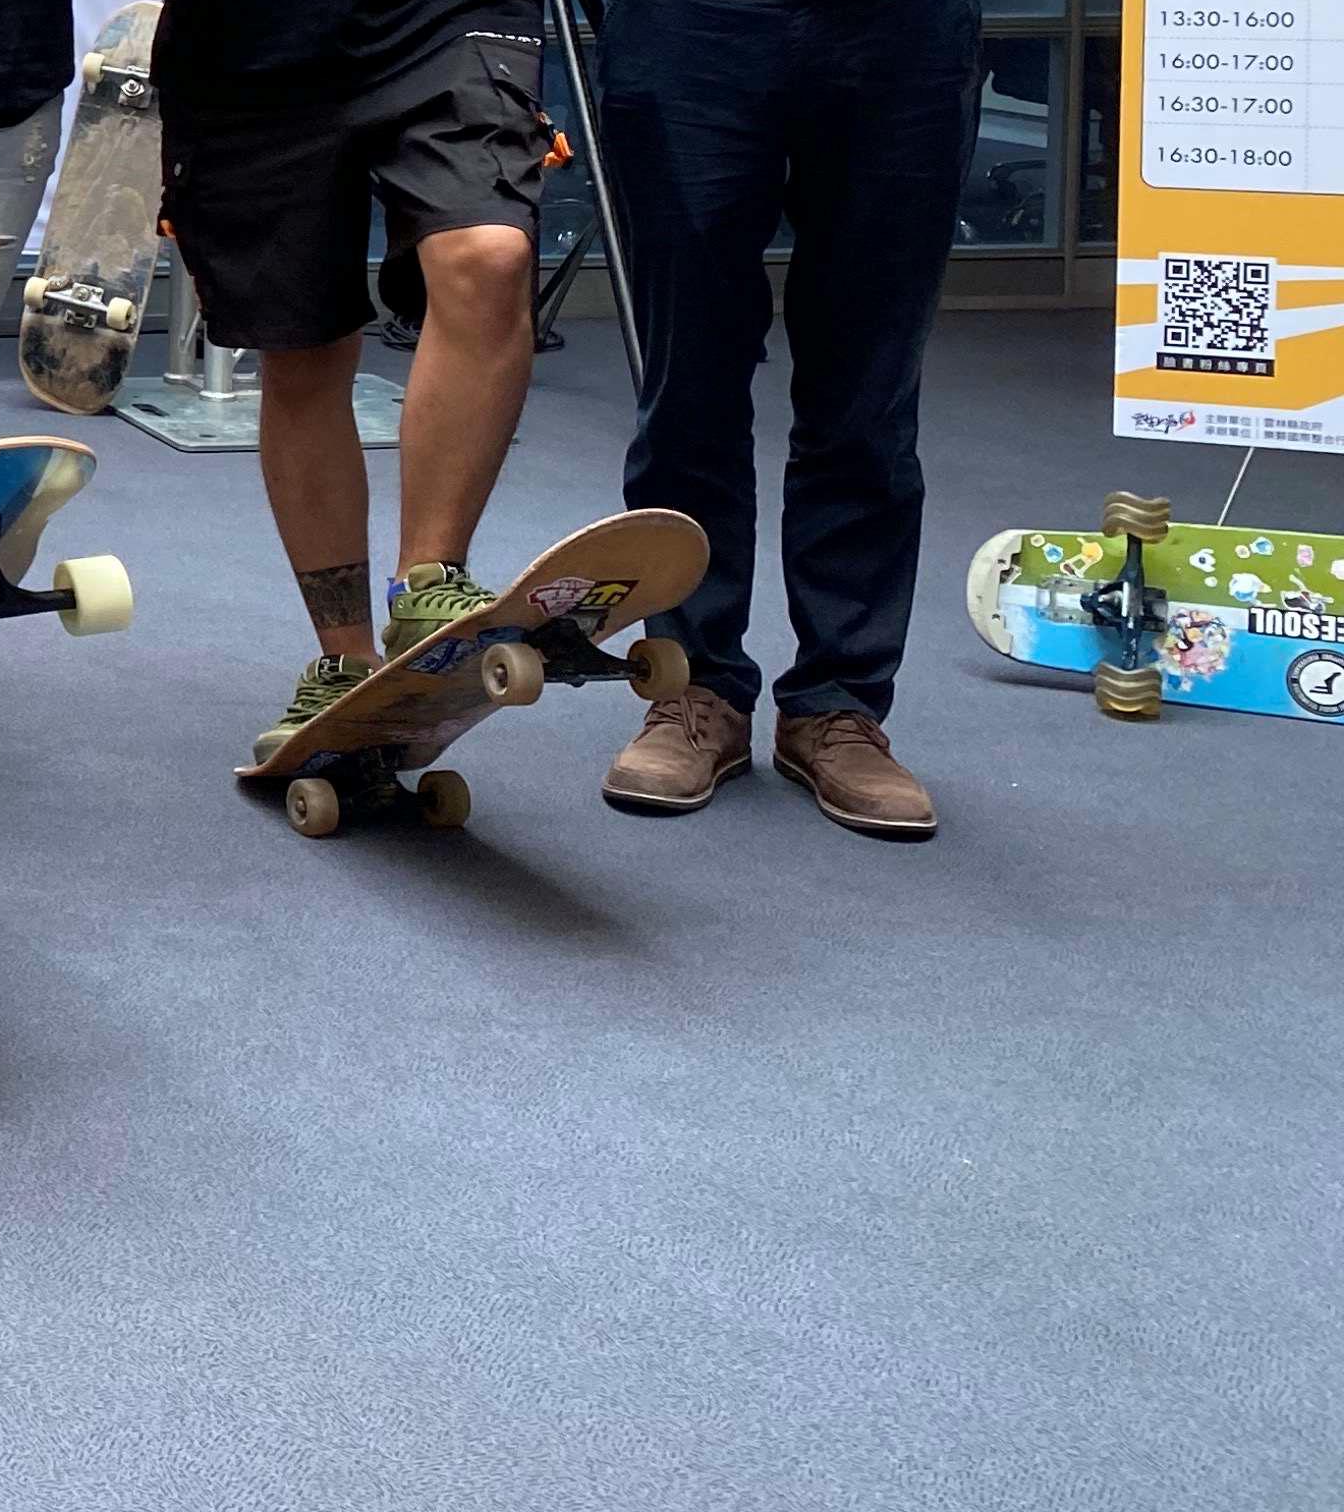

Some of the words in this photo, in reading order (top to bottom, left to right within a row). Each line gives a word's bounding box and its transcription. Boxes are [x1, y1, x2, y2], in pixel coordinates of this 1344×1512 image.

[1161, 10, 1294, 28] 13:30-16:00
[1160, 53, 1293, 71] 16:00-17:00
[1159, 96, 1292, 115] 16:30-17:00
[1158, 147, 1292, 167] 16:30-18:00
